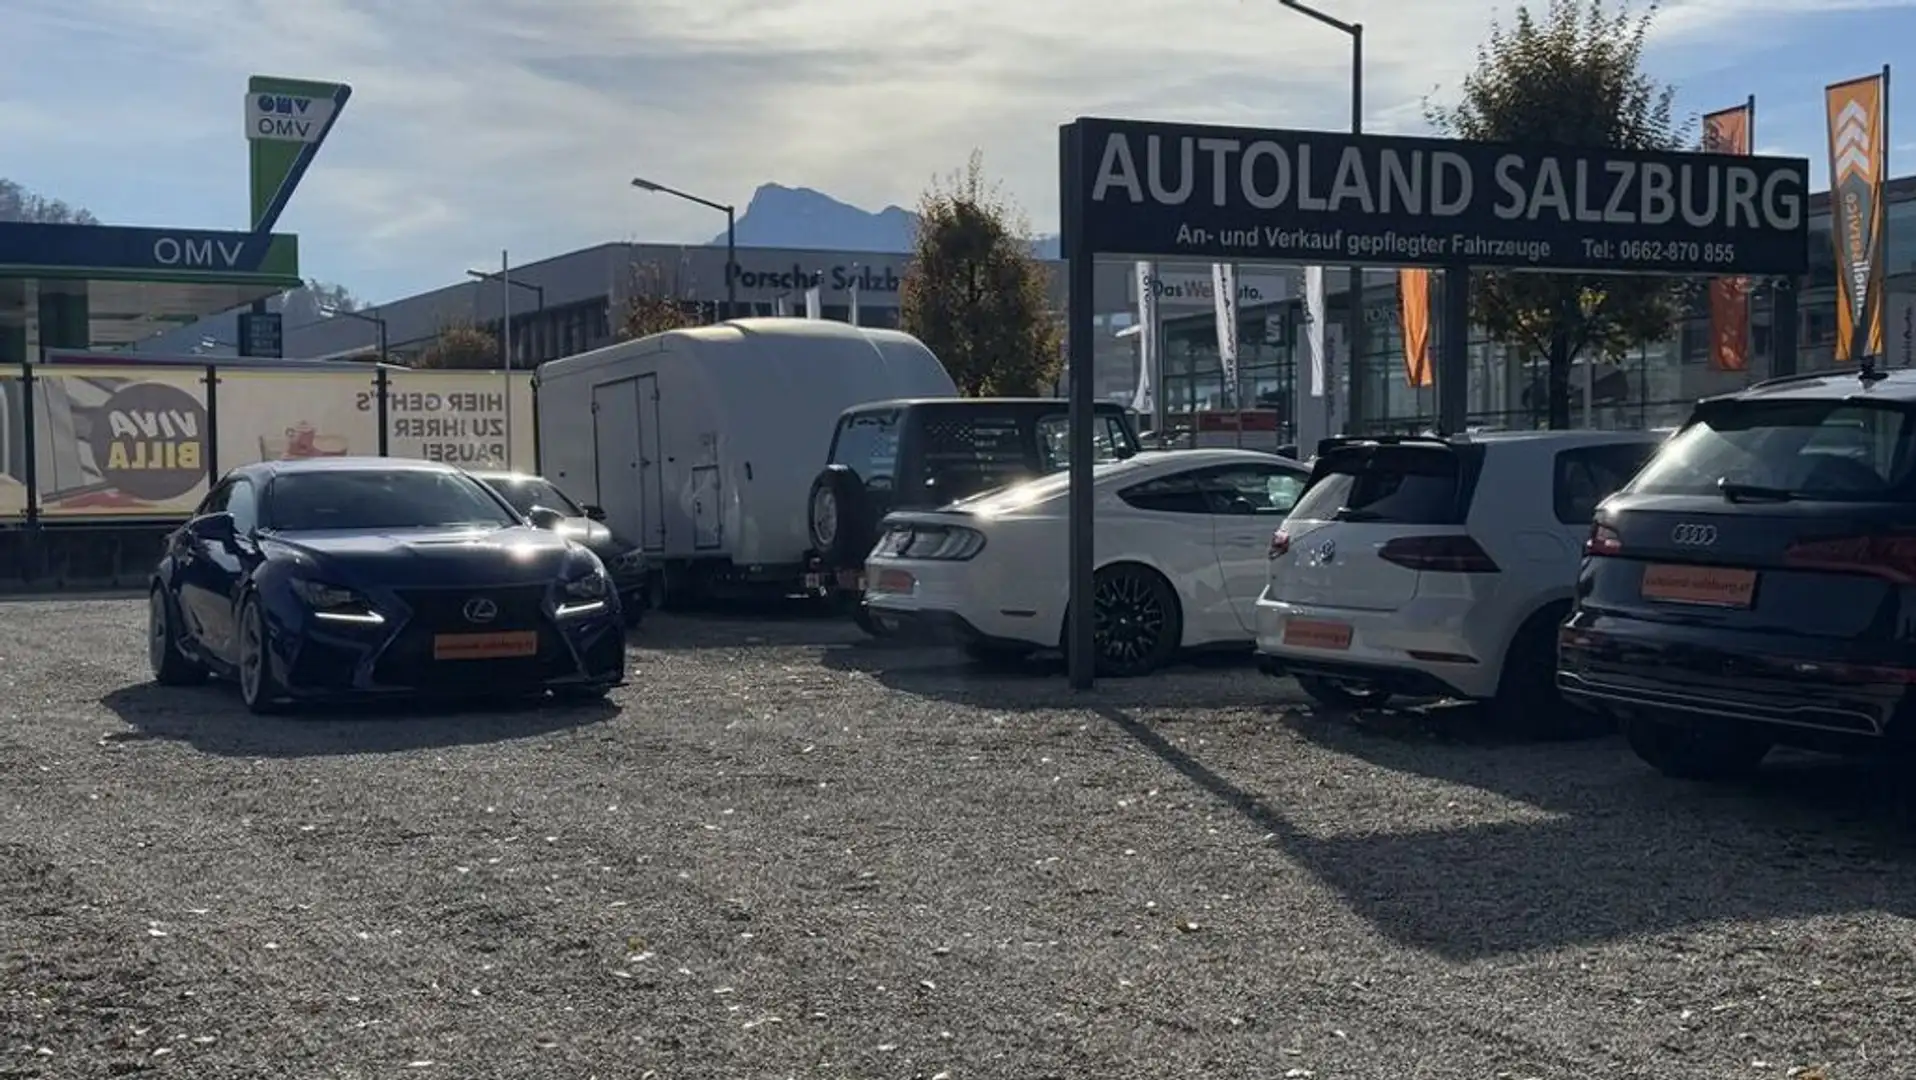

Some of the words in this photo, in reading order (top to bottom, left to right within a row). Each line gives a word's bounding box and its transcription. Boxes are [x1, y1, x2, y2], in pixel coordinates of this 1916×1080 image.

[258, 117, 310, 138] OMV
[1092, 132, 1473, 217] AUTOLAND
[1493, 153, 1801, 231] SALZBURG
[154, 237, 245, 266] OMV
[1176, 223, 1215, 245] An-
[1220, 226, 1259, 247] und
[1264, 226, 1343, 250] Verkauf
[1347, 231, 1447, 258] gepflegter
[1451, 233, 1551, 262] Fahrzeuge
[1581, 238, 1616, 260] Tel:
[1620, 240, 1700, 262] 0662-870
[1704, 242, 1736, 264] 855
[725, 261, 825, 290] Porsche
[831, 265, 900, 292] Salzb
